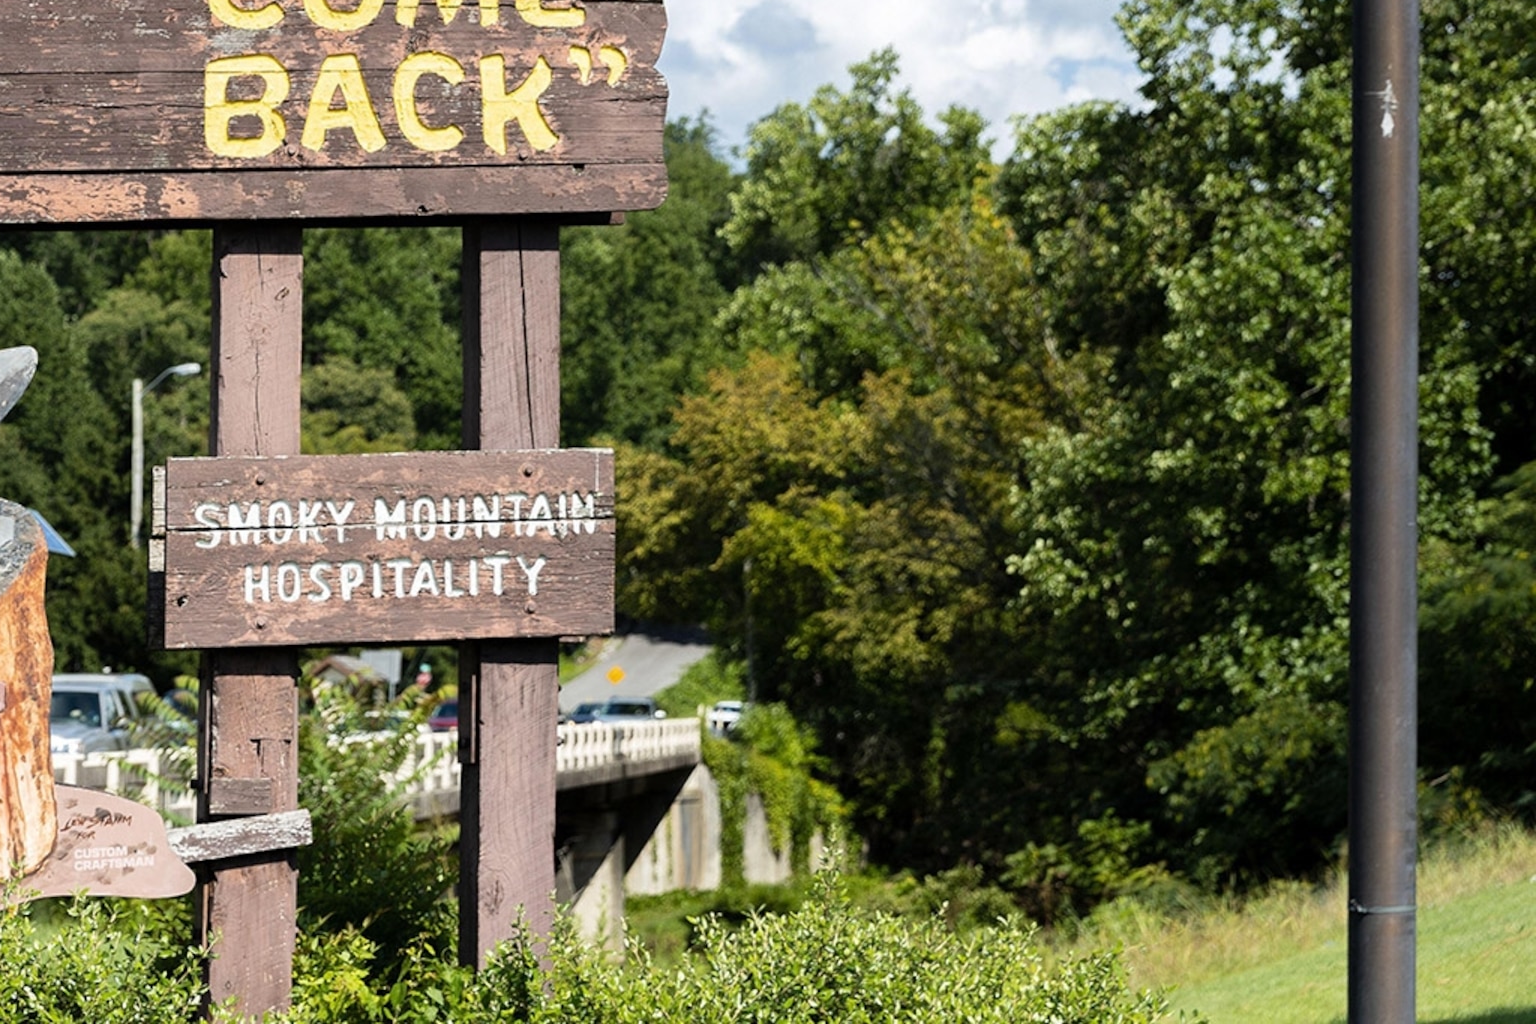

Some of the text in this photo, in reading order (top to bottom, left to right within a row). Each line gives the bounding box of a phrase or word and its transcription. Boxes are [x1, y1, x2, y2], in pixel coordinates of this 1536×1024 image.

[194, 491, 597, 549] SMOKY MOUNTAIN
[244, 553, 548, 605] HOSPITALITY
[74, 845, 128, 859] CUSTOM
[74, 856, 154, 871] CRAFTSMAN
